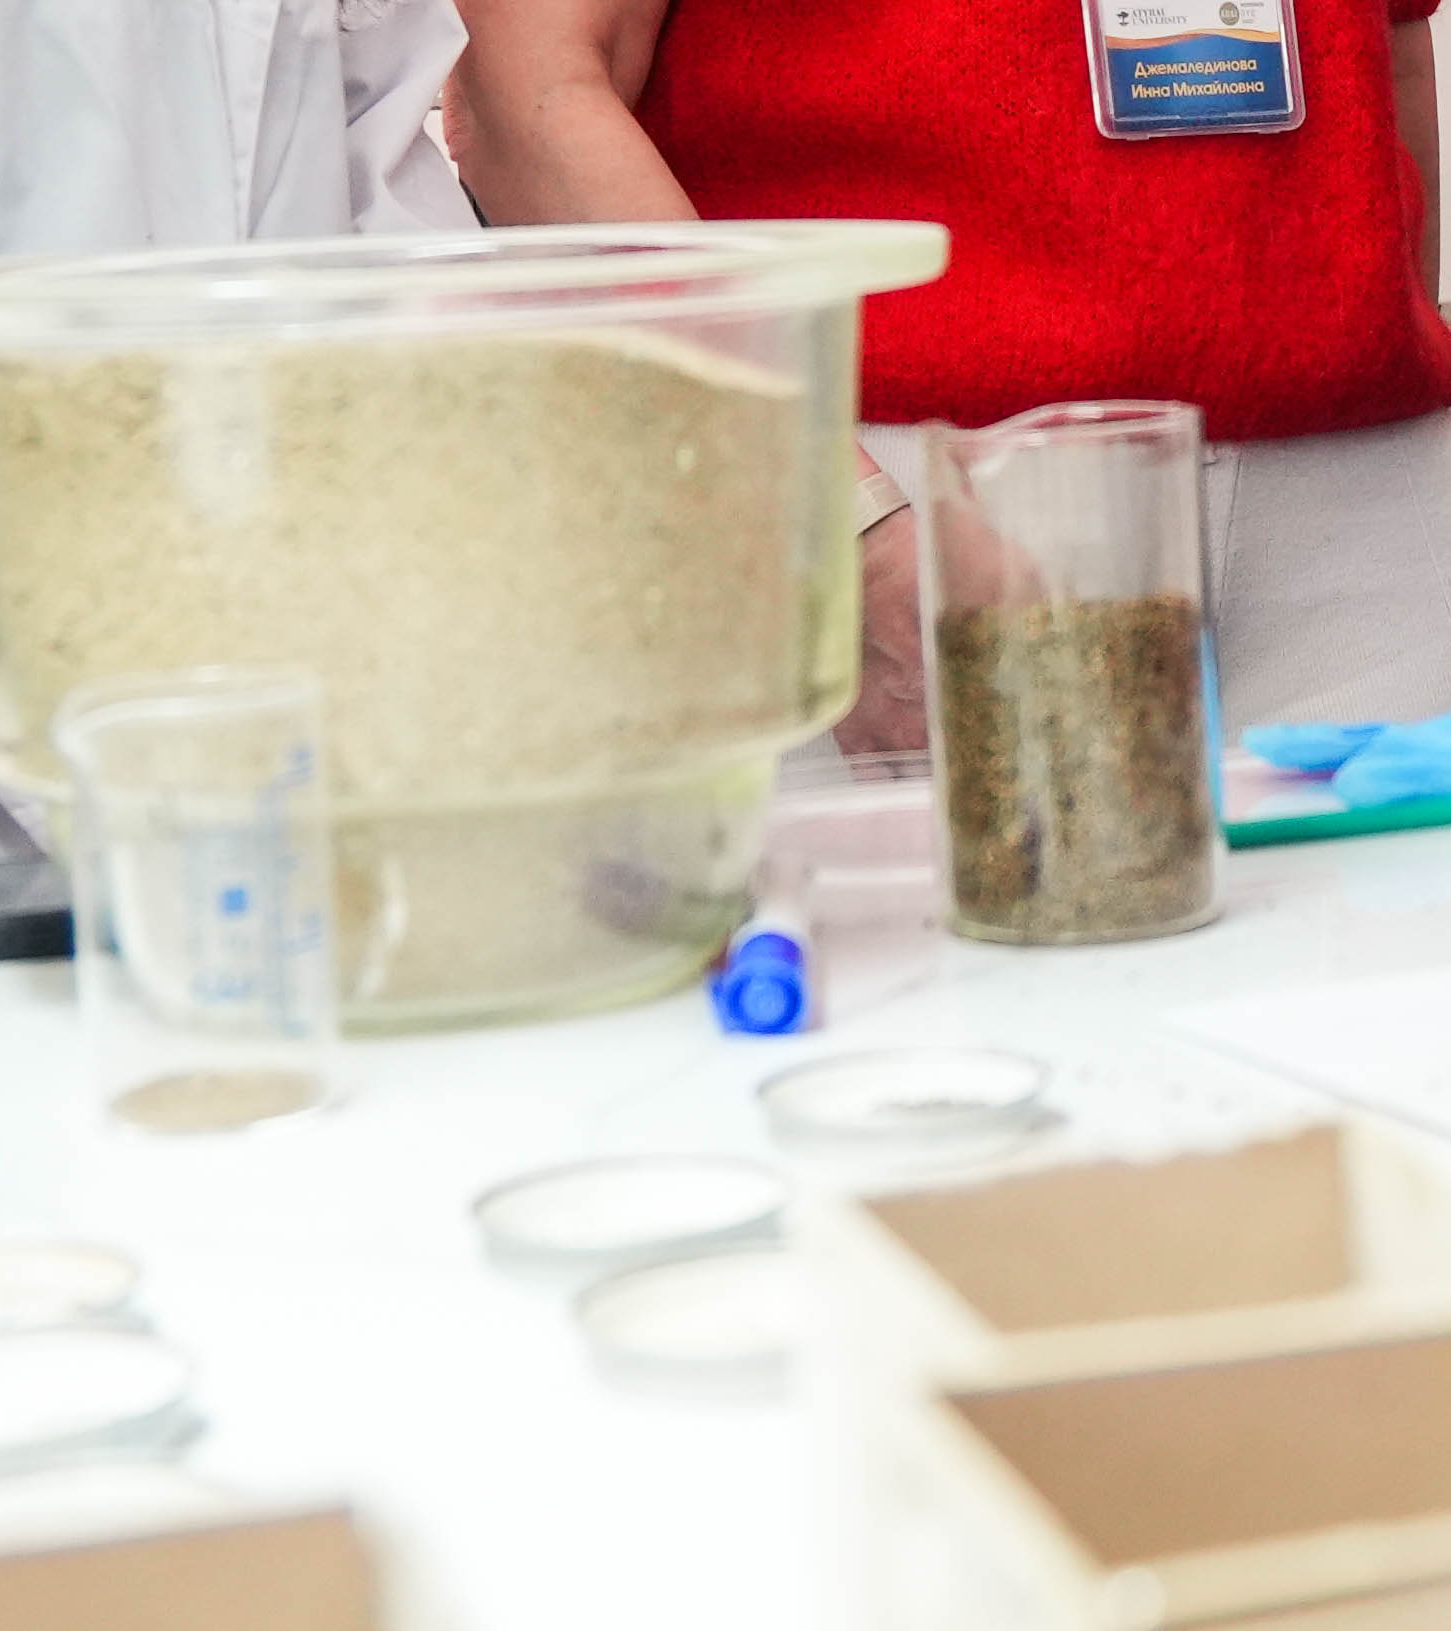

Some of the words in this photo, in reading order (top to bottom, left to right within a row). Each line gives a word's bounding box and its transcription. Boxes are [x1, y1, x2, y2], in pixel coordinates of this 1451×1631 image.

[1132, 16, 1188, 25] UNIVERSITY
[1134, 59, 1257, 79] Джемалединова
[1131, 85, 1170, 99] Инна
[1173, 79, 1265, 97] Михайловна
